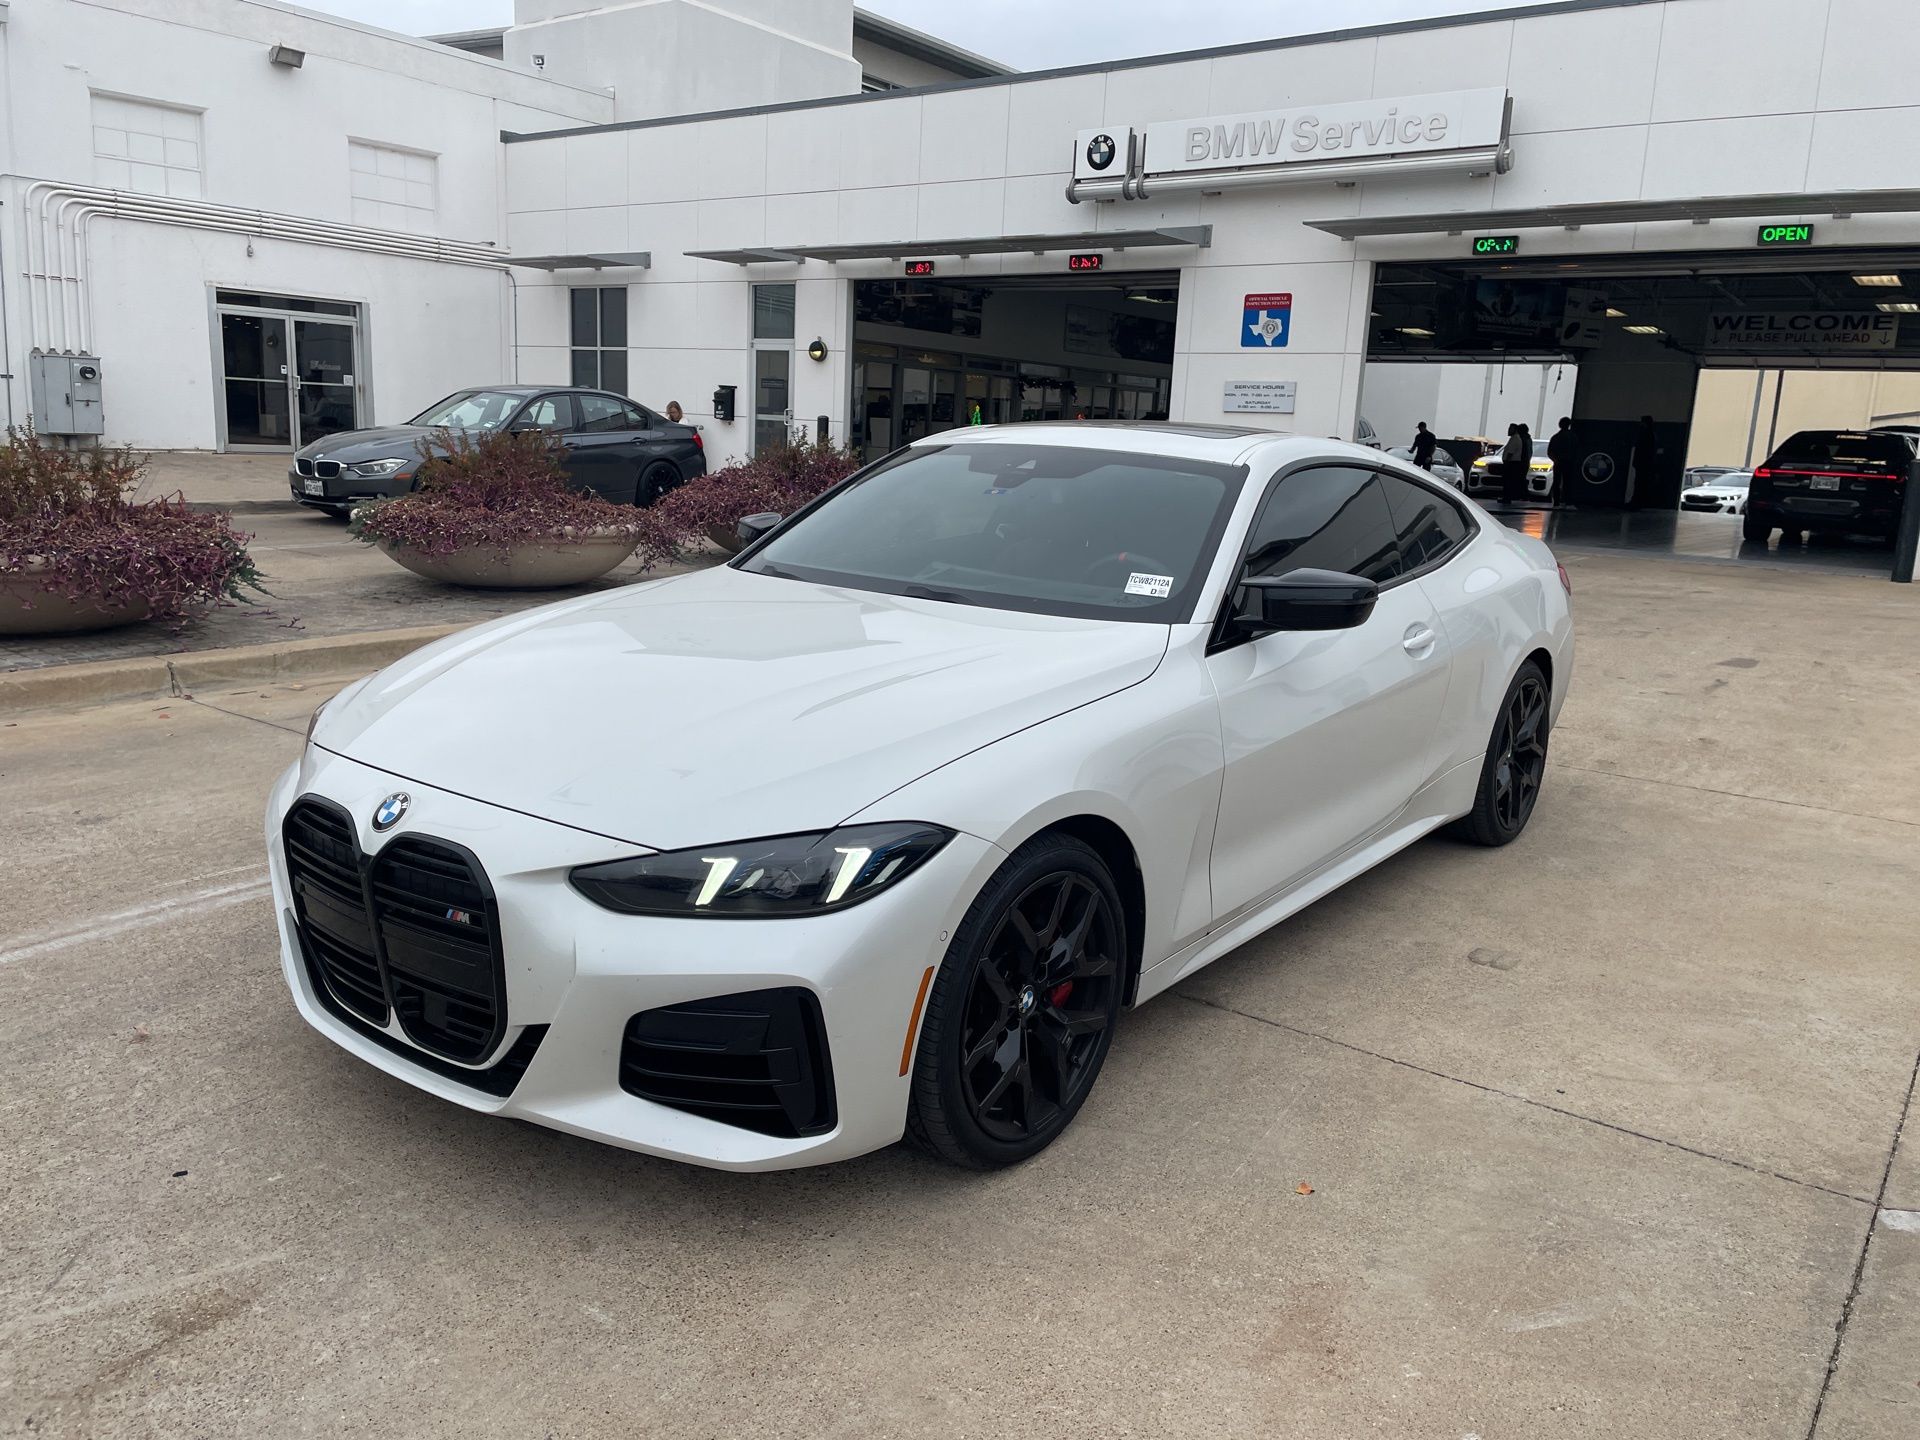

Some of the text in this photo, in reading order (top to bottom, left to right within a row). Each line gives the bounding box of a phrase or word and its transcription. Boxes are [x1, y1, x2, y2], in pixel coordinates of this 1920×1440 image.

[1185, 106, 1448, 162] BMW Service
[1763, 226, 1809, 241] OPEN
[1476, 239, 1513, 251] OPN
[1713, 315, 1895, 331] WELCOME
[1728, 332, 1870, 343] PLEASE PULL AHEAD
[1130, 575, 1170, 587] TCW82112A
